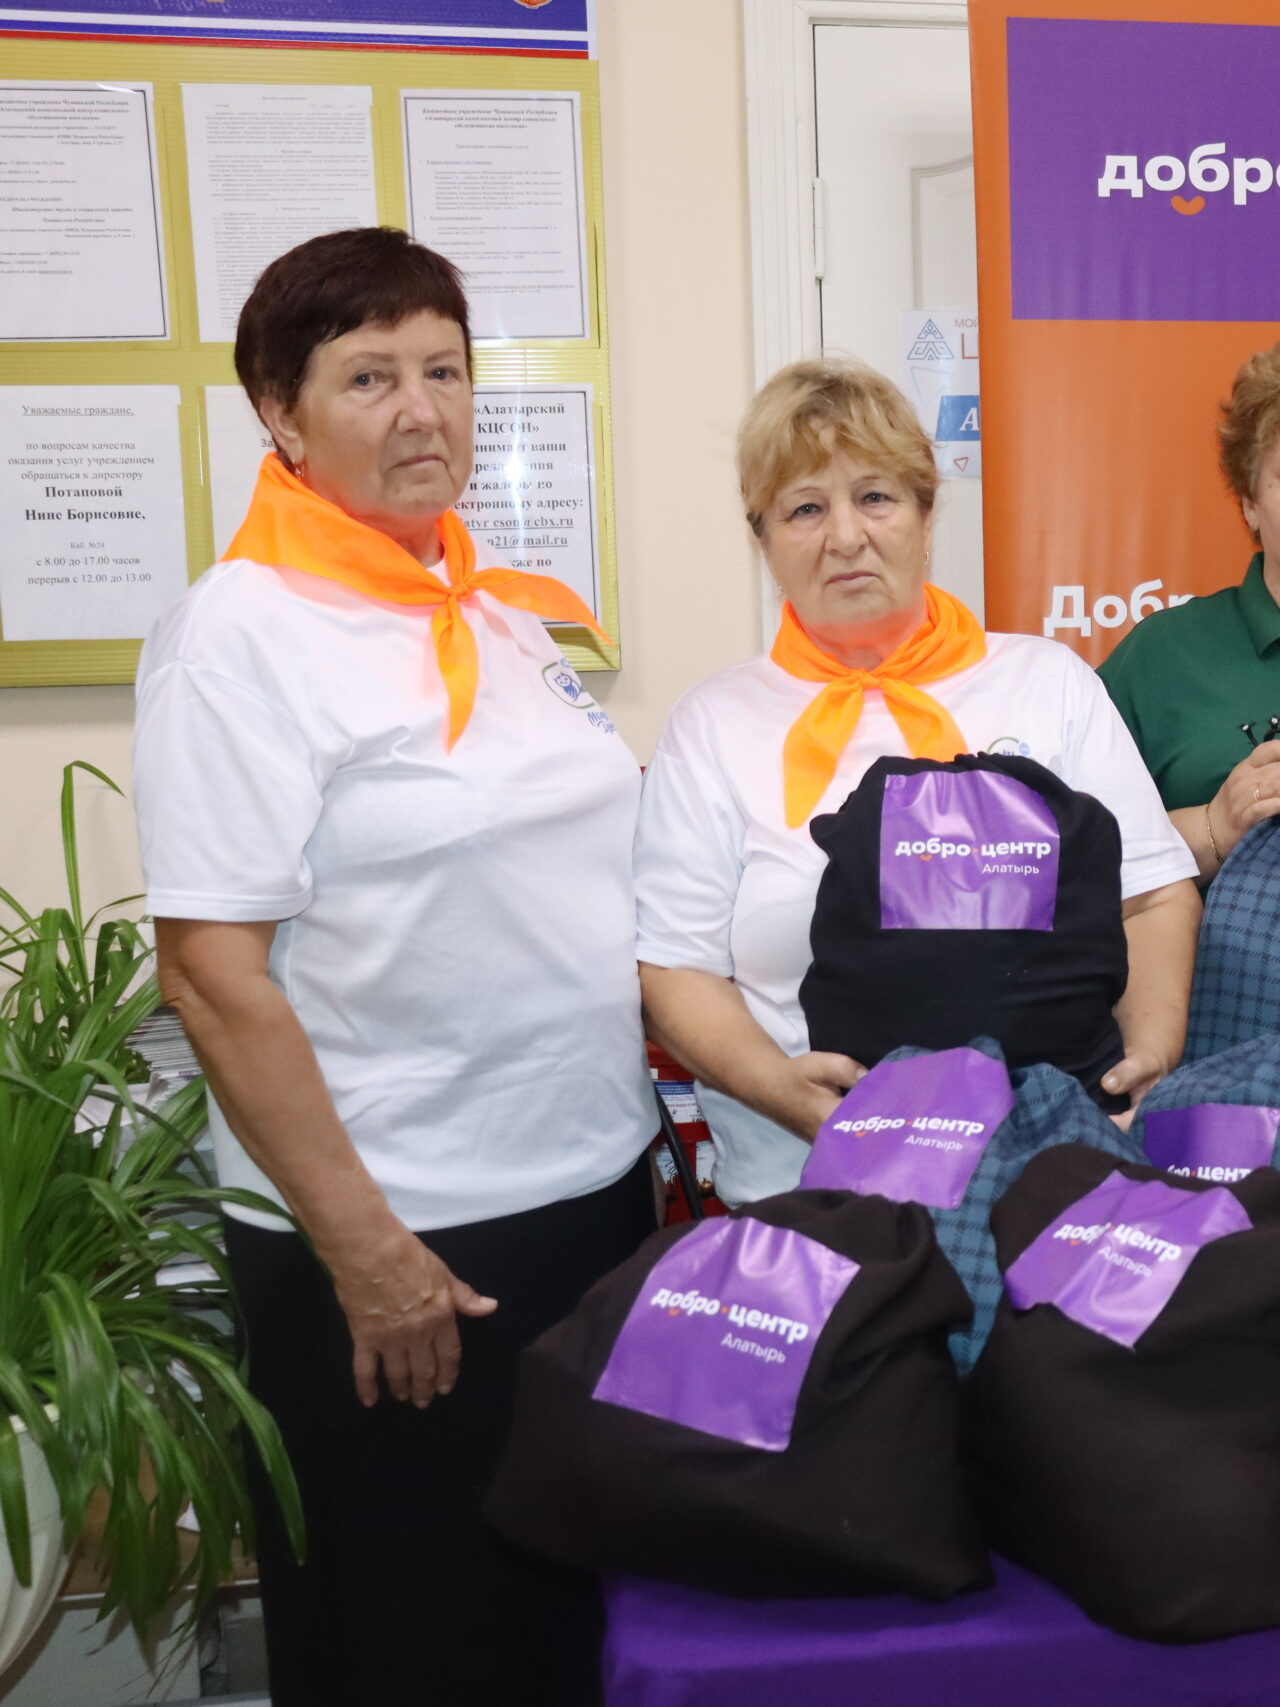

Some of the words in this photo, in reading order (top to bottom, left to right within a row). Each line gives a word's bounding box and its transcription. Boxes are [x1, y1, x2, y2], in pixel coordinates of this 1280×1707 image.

[22, 405, 81, 416] Уважаемые
[26, 442, 38, 450] по
[41, 441, 89, 451] вопросам
[92, 441, 136, 450] качества
[531, 443, 566, 452] ваши
[8, 457, 53, 465] оказания
[56, 457, 84, 467] услуг
[87, 456, 155, 467] учреждением
[21, 470, 81, 481] обращаться
[91, 471, 144, 481] директору
[45, 485, 123, 498] Потаповой
[536, 499, 584, 510] адресу:
[25, 509, 63, 521] Нине
[67, 508, 146, 523] Борисовне,
[44, 557, 66, 566] 8.00
[68, 558, 81, 567] до
[84, 556, 110, 565] 17.00
[112, 557, 141, 565] часов
[28, 576, 71, 586] перерыв
[81, 573, 108, 583] 12.00
[110, 575, 122, 583] до
[125, 573, 152, 582] 13.00
[895, 837, 971, 858] добро
[981, 841, 1052, 859] центр
[982, 863, 1040, 876] Алатырь
[833, 1116, 906, 1133] добро
[912, 1116, 985, 1136] центр
[904, 1134, 963, 1152] Алатырь
[1196, 1165, 1252, 1182] цент
[1112, 1223, 1182, 1263] центр
[650, 1287, 721, 1316] добро
[728, 1304, 809, 1344] центр
[721, 1332, 786, 1364] Алатырь
